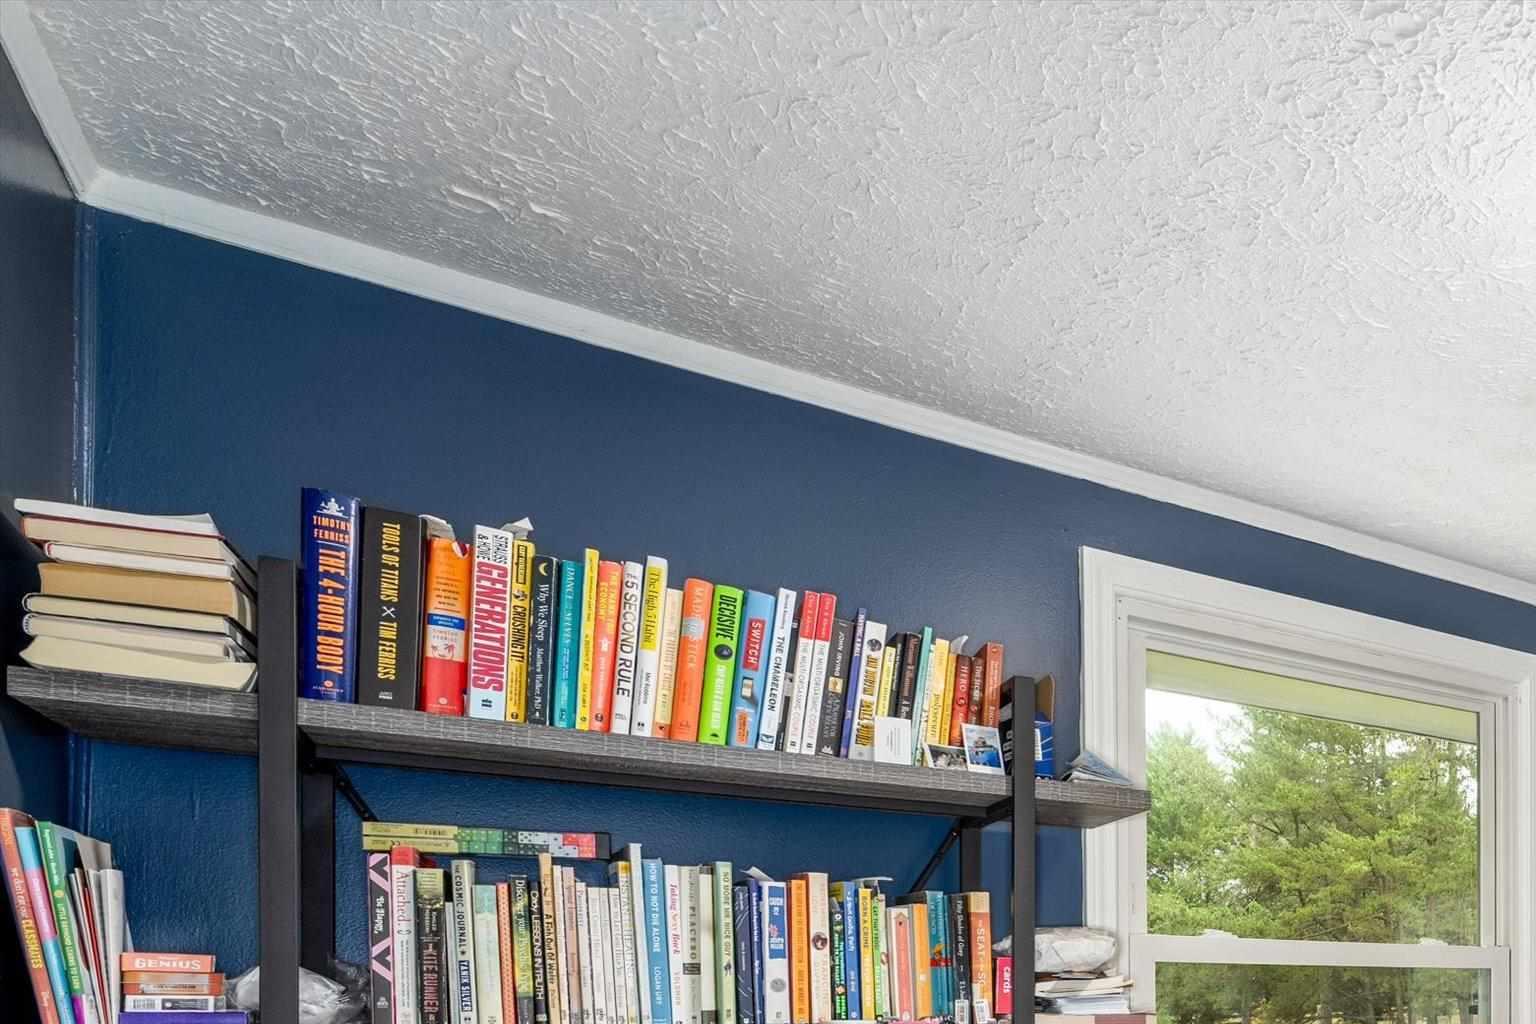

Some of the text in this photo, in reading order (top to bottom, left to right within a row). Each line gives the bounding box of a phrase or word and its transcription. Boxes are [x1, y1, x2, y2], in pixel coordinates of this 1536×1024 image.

[313, 515, 352, 531] TIMOTHY
[313, 530, 352, 545] FERRISS
[494, 534, 508, 564] STRAUSS
[376, 522, 400, 681] TOOLS OF TITANS TIM FERRISS
[537, 604, 547, 617] We
[538, 583, 548, 603] Why
[644, 573, 660, 643] The High Habit
[316, 549, 346, 674] THE 4-HOUR BODY
[472, 562, 508, 692] GENERATIONS
[535, 617, 547, 640] Sleep
[716, 595, 737, 641] DECISIVE
[511, 605, 527, 663] CRUSHING IT!
[616, 581, 636, 697] 5 SECOND RULE
[747, 622, 760, 664] SWITCH
[768, 636, 785, 711] THE CHAMELEON
[834, 652, 843, 676] IRVING
[648, 863, 657, 881] HOW
[650, 883, 658, 894] TO
[396, 870, 412, 926] Attached.
[454, 875, 464, 907] COSMIC
[651, 896, 659, 911] NOT
[22, 919, 43, 969] CLASSMATES
[457, 910, 466, 948] JOURNAL
[532, 914, 542, 957] LESSONS
[652, 927, 661, 952] ALONE
[689, 905, 697, 960] PLACEBO
[134, 958, 201, 969] GENIUS
[1003, 966, 1011, 993] cards
[423, 950, 439, 1013] KITE RUNNER
[460, 984, 472, 1011] SILVER
